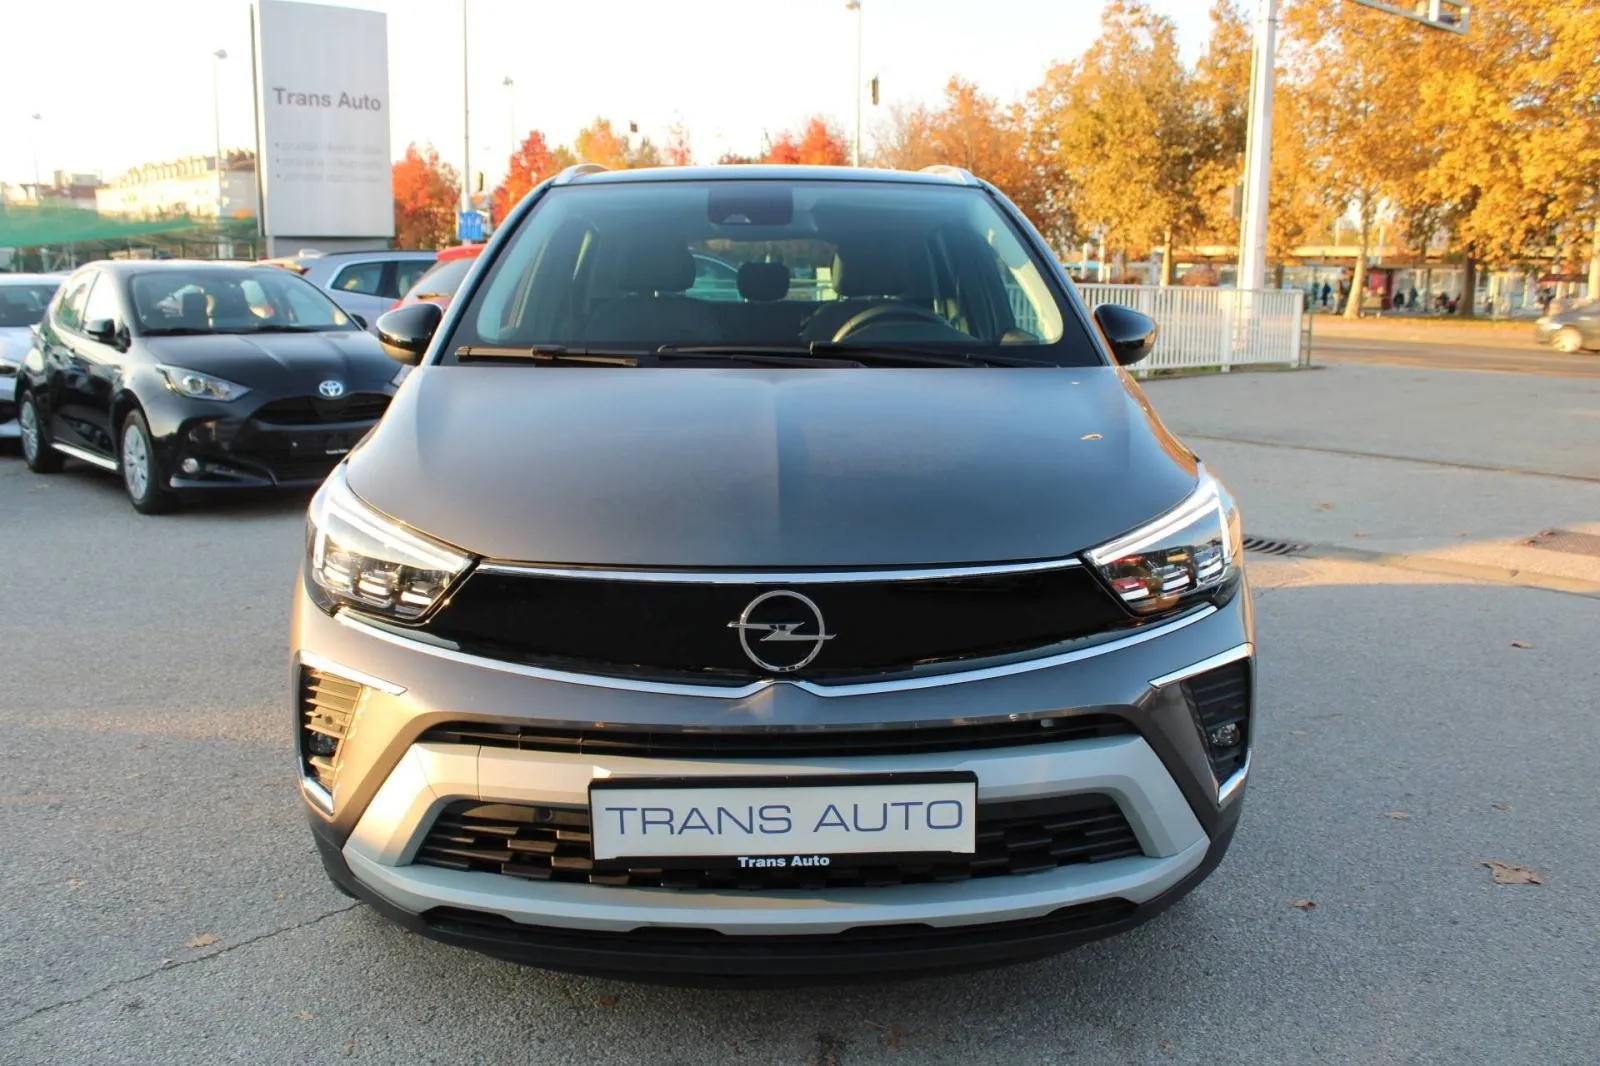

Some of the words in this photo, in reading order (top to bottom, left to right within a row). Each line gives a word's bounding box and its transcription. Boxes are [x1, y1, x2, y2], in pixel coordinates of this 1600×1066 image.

[272, 87, 332, 107] Trans
[337, 91, 382, 111] Auto
[605, 804, 793, 835] TRANS
[812, 799, 964, 833] AUTO
[737, 856, 786, 868] Trans
[791, 855, 830, 867] Auto
